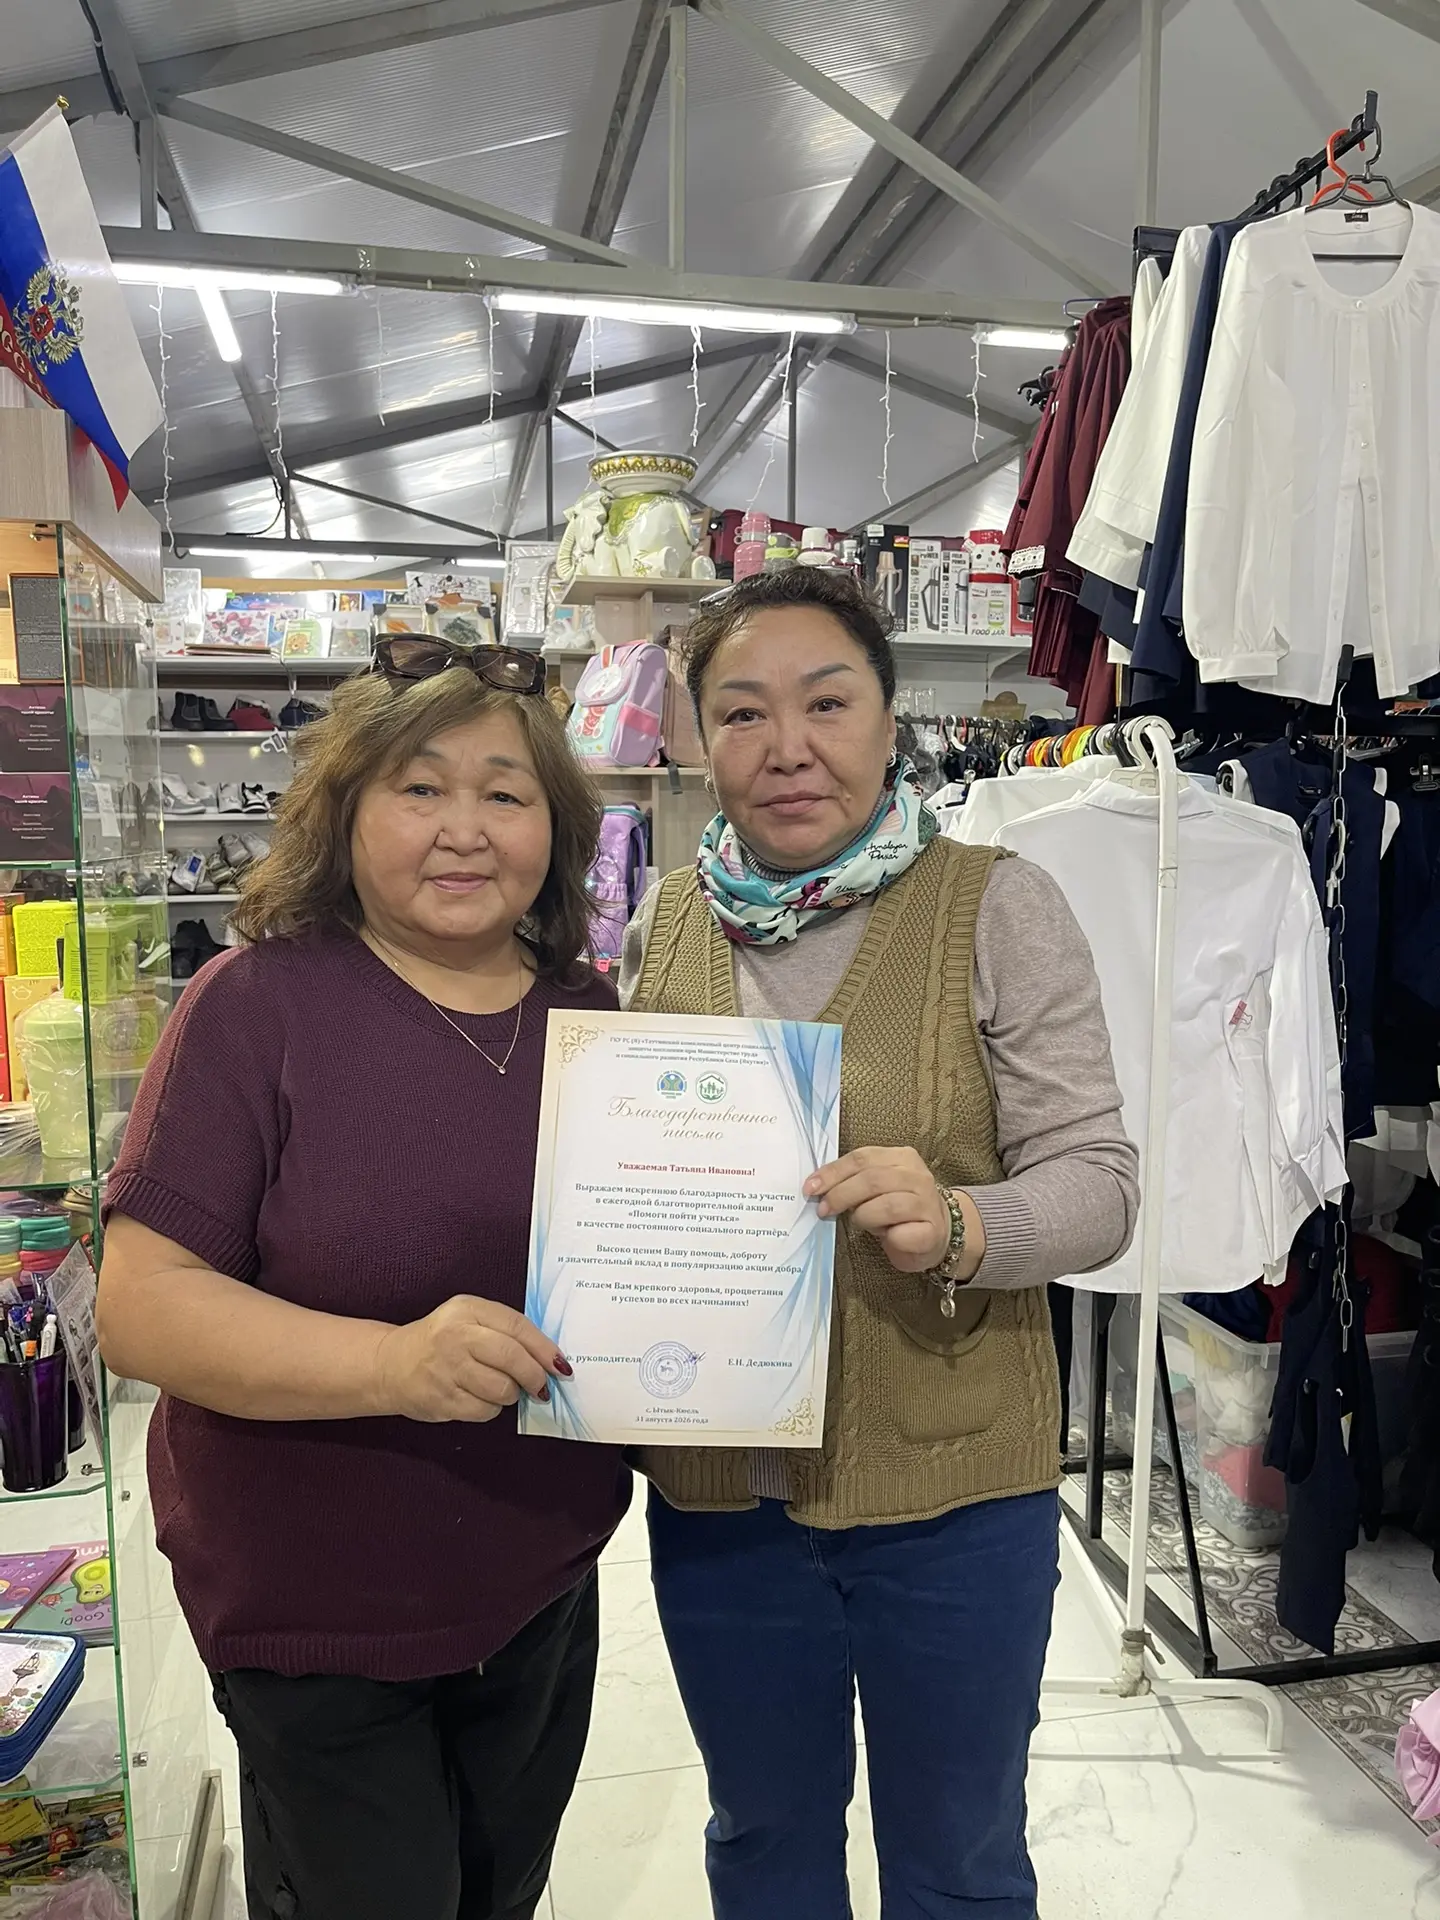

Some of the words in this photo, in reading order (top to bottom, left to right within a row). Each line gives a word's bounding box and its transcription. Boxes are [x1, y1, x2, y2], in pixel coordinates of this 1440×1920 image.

[688, 1056, 724, 1064] Республики
[608, 1095, 778, 1127] Благодарственное
[661, 1125, 724, 1141] письмо
[617, 1161, 668, 1172] Уважаемая
[669, 1164, 706, 1173] Татьяна
[708, 1166, 756, 1176] Ивановна!
[575, 1183, 623, 1194] Выражаем
[625, 1186, 678, 1196] искреннюю
[679, 1188, 747, 1199] благодарность
[760, 1194, 796, 1202] участие
[602, 1198, 652, 1207] ежегодной
[654, 1199, 744, 1212] благотворительной
[745, 1205, 774, 1213] акции
[628, 1209, 668, 1219] «Помоги
[669, 1212, 697, 1221] пойти
[698, 1214, 740, 1223] учиться»
[583, 1220, 624, 1230] качестве
[626, 1223, 684, 1232] постоянного
[686, 1226, 744, 1236] социального
[745, 1228, 790, 1238] партнёра.
[596, 1244, 632, 1254] Высоко
[632, 1248, 662, 1256] ценим
[664, 1248, 688, 1258] Вашу
[690, 1250, 728, 1258] помощь,
[730, 1251, 768, 1260] доброту
[564, 1256, 632, 1266] значительный
[670, 1262, 744, 1272] популяризацию
[774, 1264, 804, 1274] добра.
[575, 1280, 612, 1290] Желаем
[614, 1282, 632, 1290] Вам
[634, 1284, 677, 1293] крепкого
[678, 1286, 723, 1295] здоровья,
[724, 1287, 784, 1296] процветания
[618, 1296, 656, 1304] успехов
[691, 1299, 750, 1308] начинаниях!
[576, 1354, 642, 1364] руководителя
[746, 1358, 793, 1368] Дедюкина
[644, 1416, 673, 1424] августа
[60, 1611, 105, 1626] GOOD!
